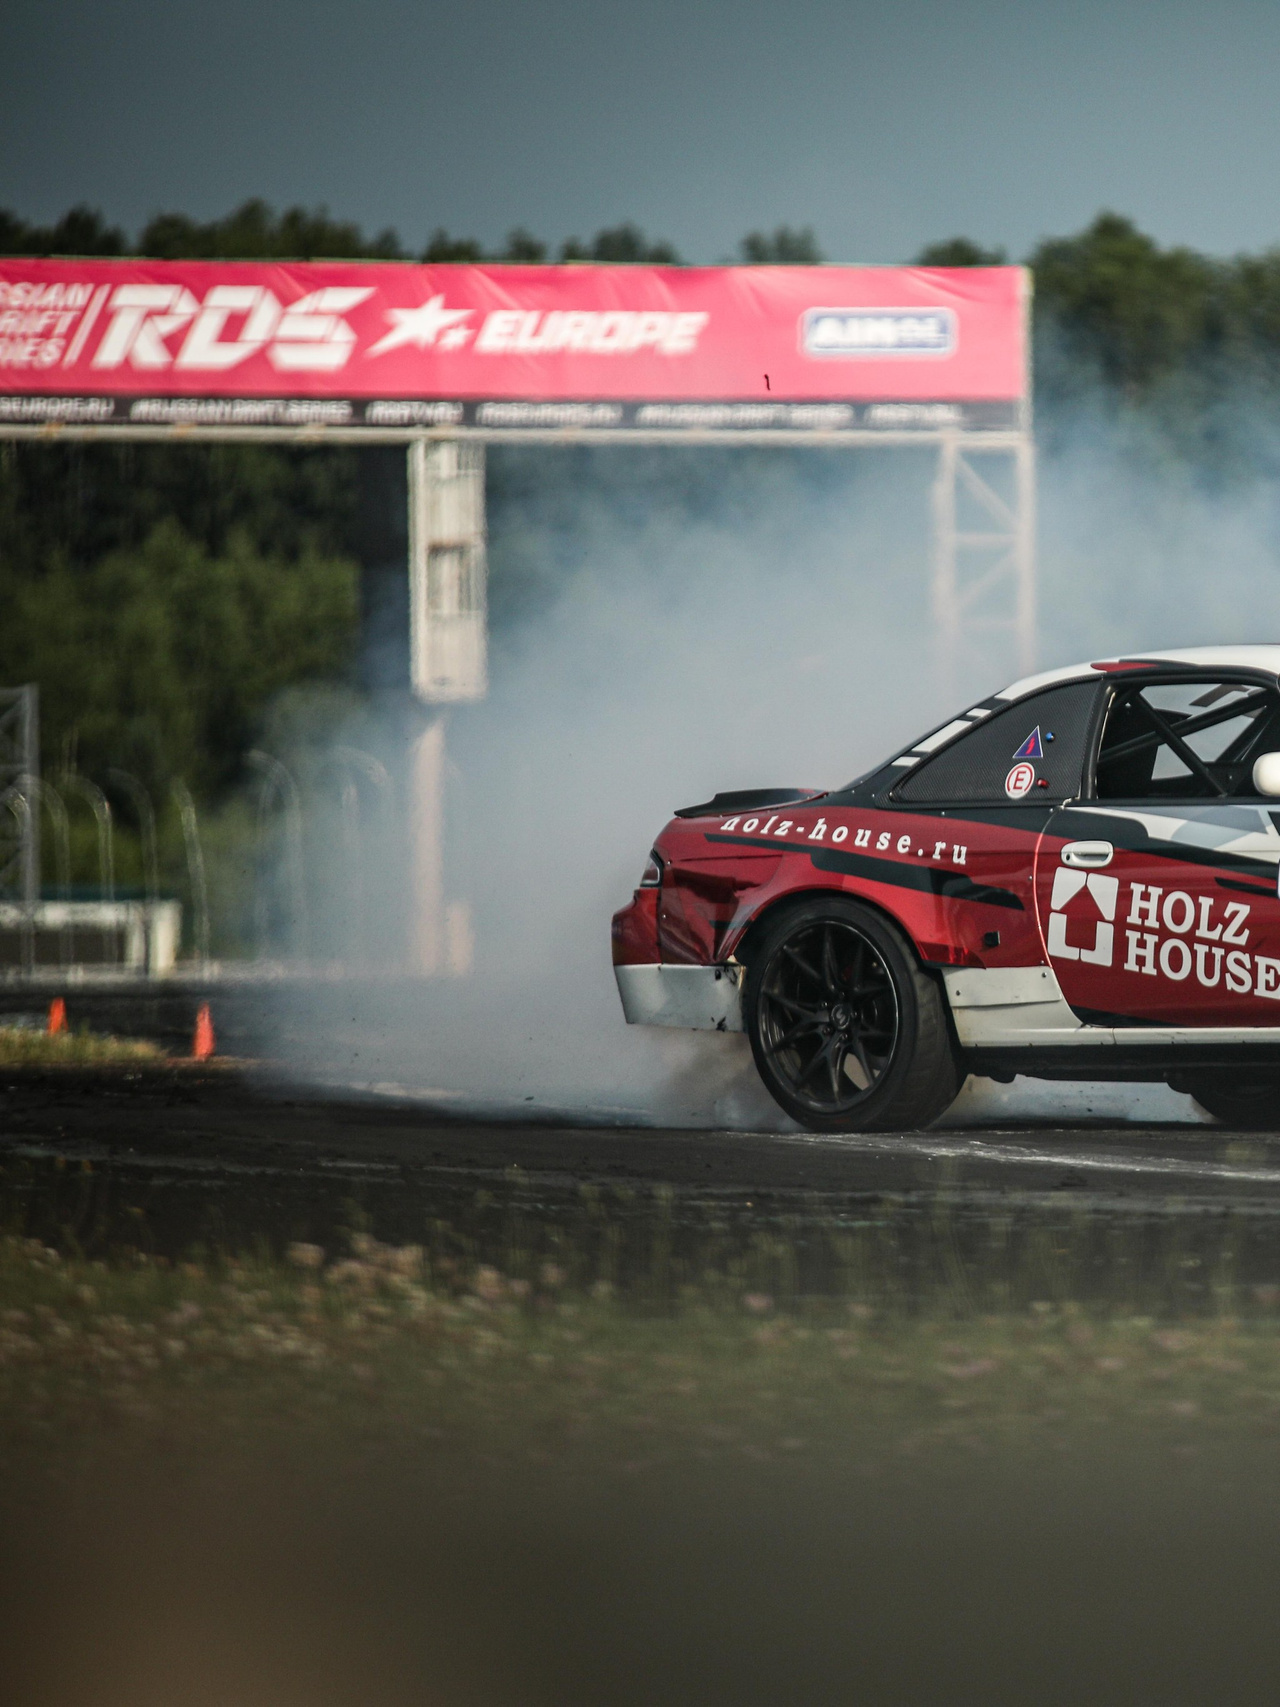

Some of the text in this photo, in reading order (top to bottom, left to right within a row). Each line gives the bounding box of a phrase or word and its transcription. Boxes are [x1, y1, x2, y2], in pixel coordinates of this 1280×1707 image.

[90, 284, 709, 371] RDS EUROPE
[1012, 770, 1027, 790] E
[1127, 882, 1251, 945] HOLZ
